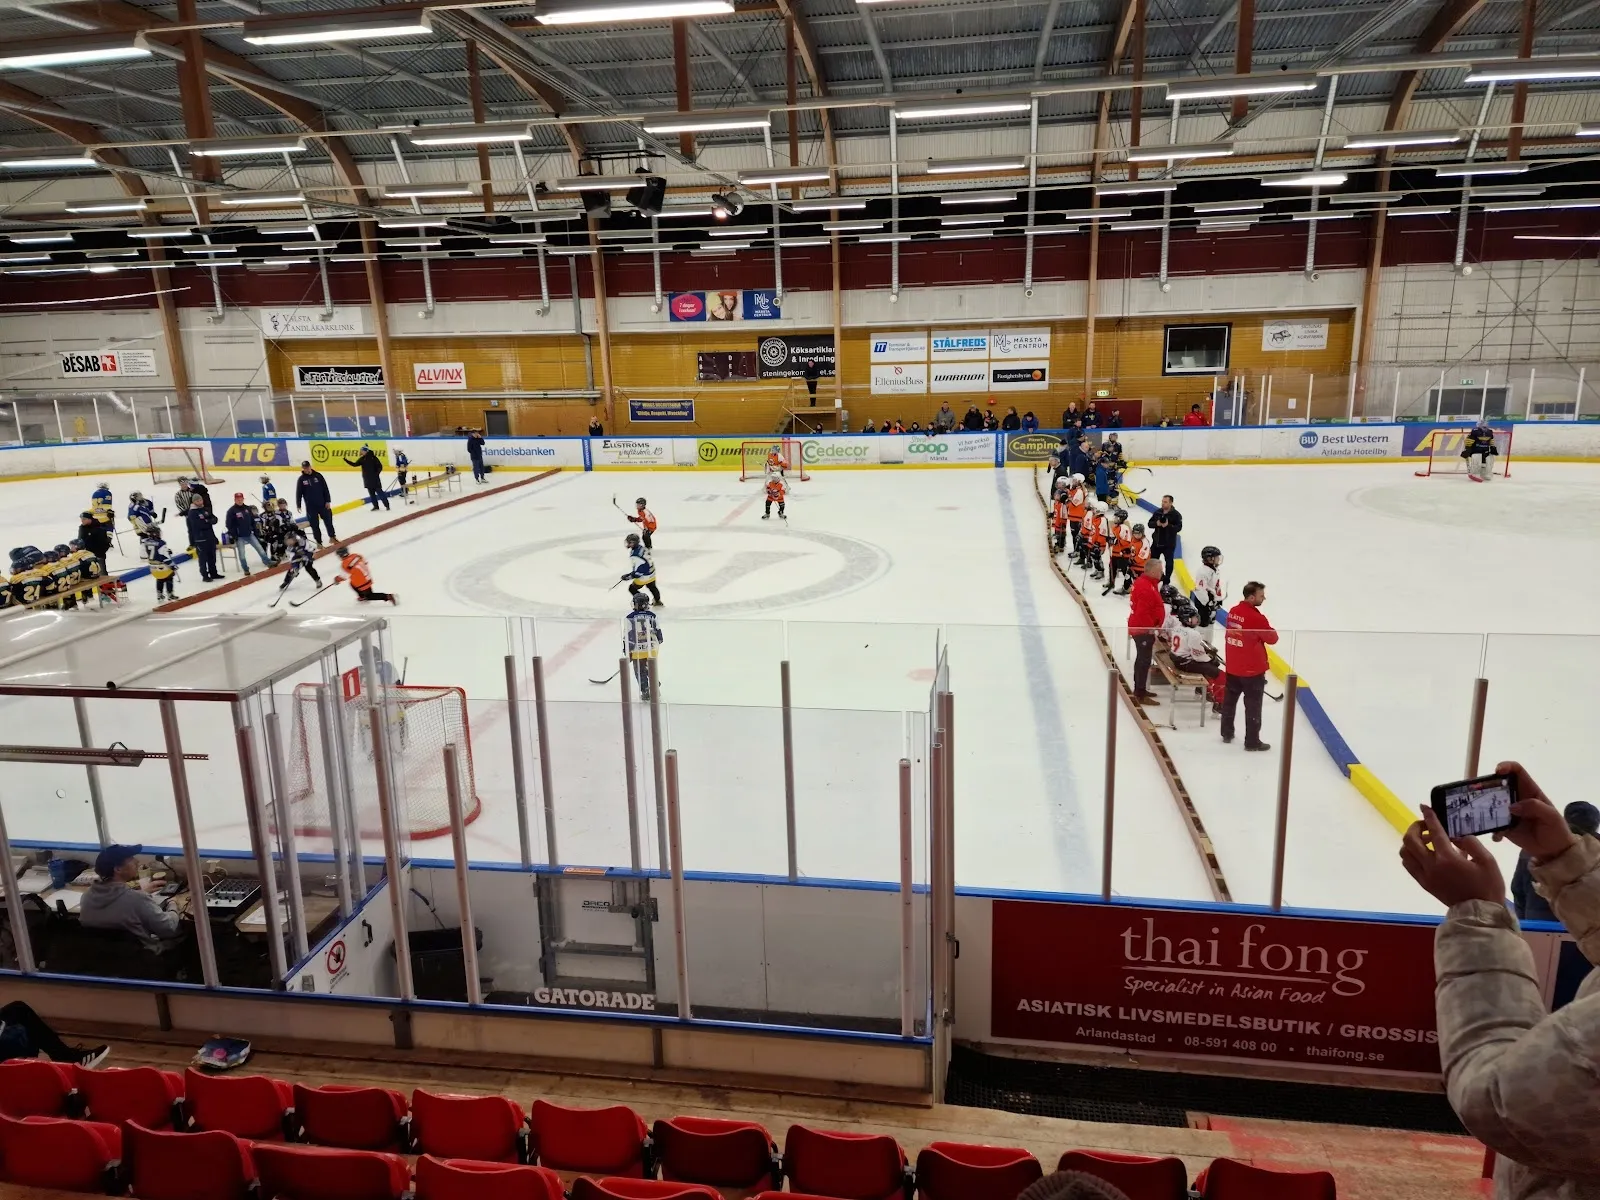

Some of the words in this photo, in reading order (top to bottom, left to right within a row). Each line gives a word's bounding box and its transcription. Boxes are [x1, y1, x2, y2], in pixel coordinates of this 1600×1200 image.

[933, 337, 987, 349] STÅLFREDS
[790, 346, 836, 354] Köksartiklar
[62, 354, 101, 373] BESAB
[791, 355, 797, 363] &
[417, 368, 463, 384] ALVINX
[934, 373, 986, 382] WARRIOR
[1301, 435, 1316, 445] BW
[1322, 436, 1344, 444] Best
[1346, 435, 1389, 443] Western
[222, 443, 276, 463] ATG
[482, 447, 555, 456] Handelsbanken
[720, 447, 772, 456] WARRIO
[802, 440, 869, 463] Cedecor
[908, 443, 949, 455] coop
[1227, 637, 1244, 648] SEB
[1120, 917, 1222, 967] thai
[1236, 924, 1369, 997] fong
[1123, 975, 1204, 996] Specialist
[1208, 981, 1224, 995] in
[1231, 982, 1273, 1001] Asian
[1279, 986, 1327, 1004] Food
[534, 987, 655, 1011] GATORADE
[1016, 999, 1112, 1019] ASIATISK
[1118, 1006, 1321, 1036] LIVSMEDELSBUTIK
[1075, 1026, 1156, 1043] Arlandastad
[1184, 1036, 1228, 1048] 08-591
[1232, 1039, 1257, 1051] 408
[1260, 1041, 1277, 1053] 00
[1306, 1045, 1385, 1062] thaifong.se
